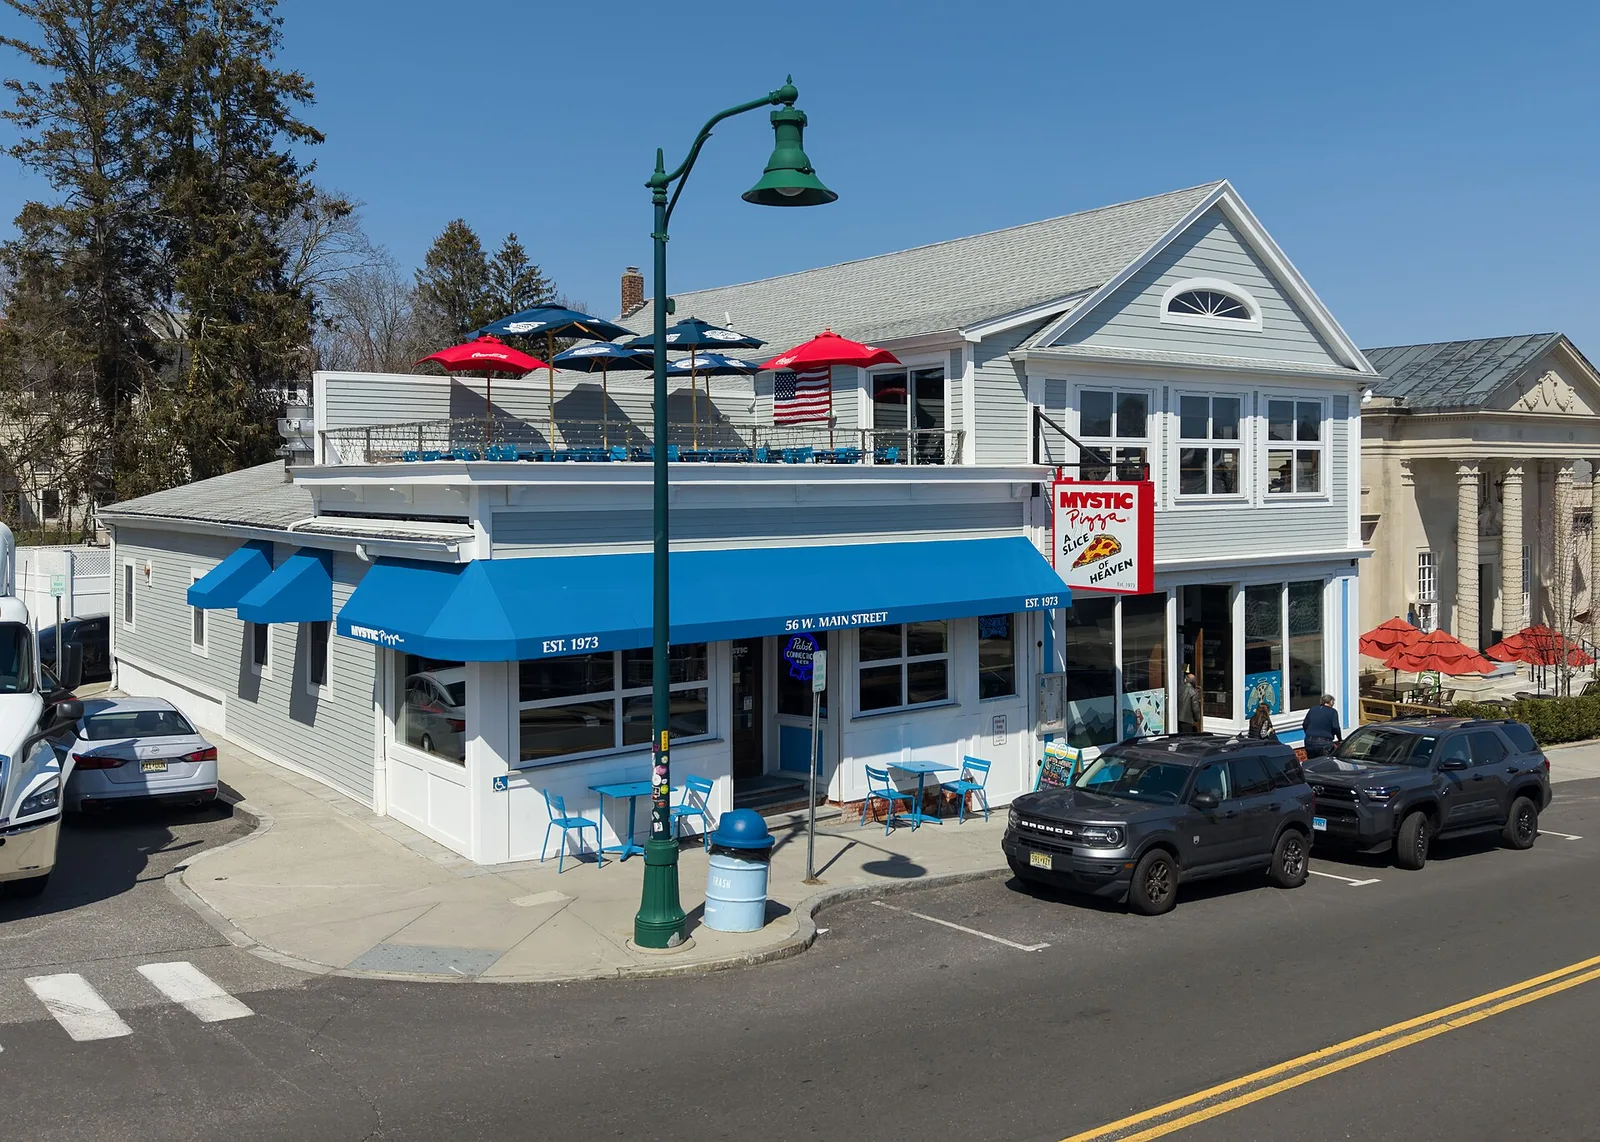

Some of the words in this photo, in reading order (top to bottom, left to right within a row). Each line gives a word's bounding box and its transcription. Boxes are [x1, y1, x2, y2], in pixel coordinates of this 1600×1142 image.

[1060, 491, 1133, 510] MYSTIC
[1065, 508, 1126, 532] Pizza
[1062, 533, 1090, 556] SLICE
[1063, 534, 1071, 545] A
[1089, 558, 1134, 585] HEAVEN
[1098, 560, 1110, 571] OF
[1025, 597, 1040, 609] EST.
[1041, 595, 1059, 607] 1973
[785, 619, 800, 631] 56
[801, 618, 816, 629] W.
[818, 615, 850, 628] MAIN
[850, 611, 889, 625] STREET
[350, 624, 379, 642] MYSTIC
[378, 629, 405, 646] Pizza
[793, 637, 813, 651] Pabst
[542, 639, 567, 654] EST.
[570, 636, 599, 651] 1973
[1021, 820, 1074, 836] BRONCO
[712, 876, 732, 889] TRASH
